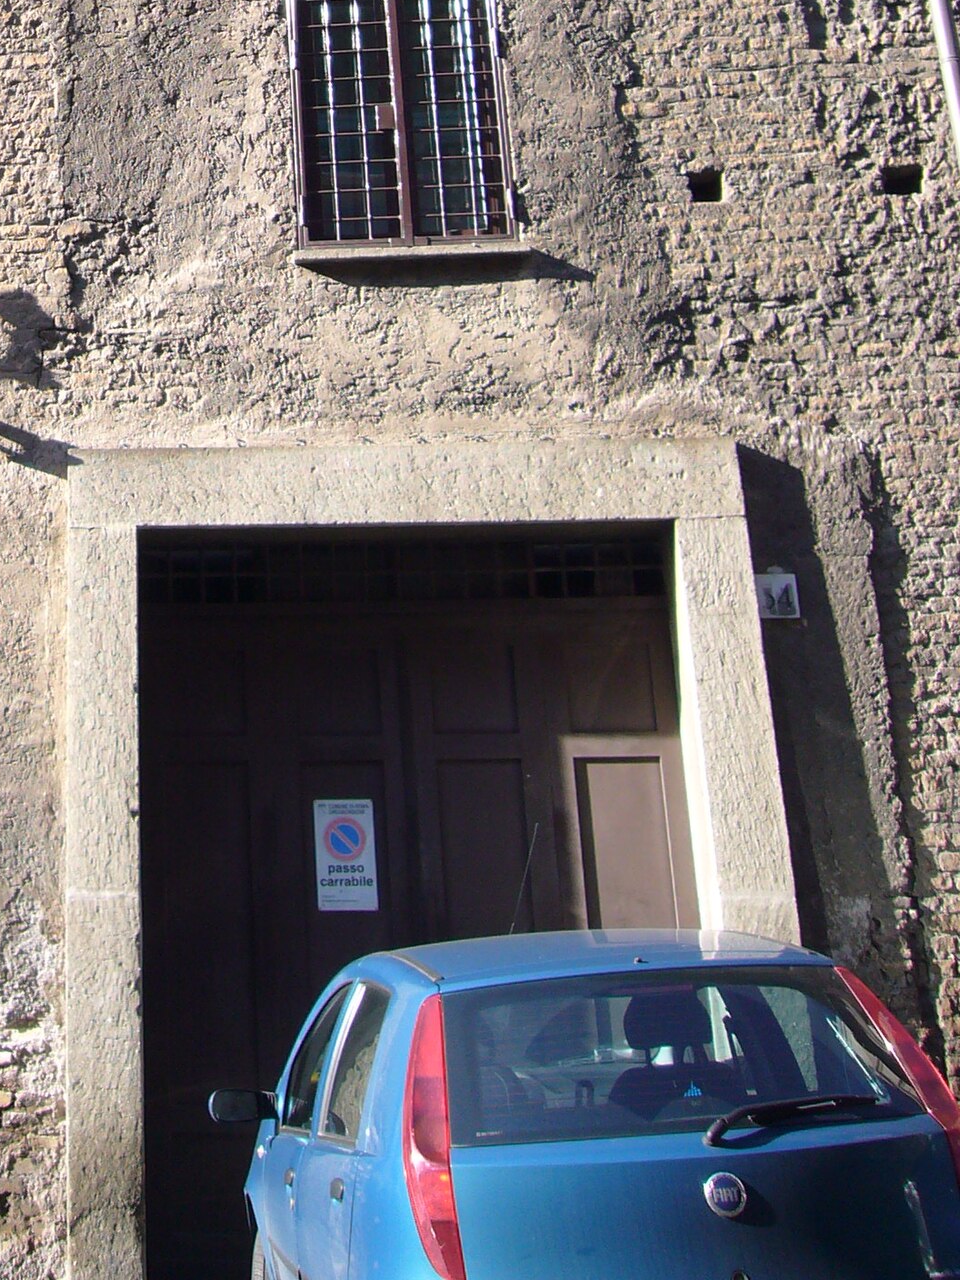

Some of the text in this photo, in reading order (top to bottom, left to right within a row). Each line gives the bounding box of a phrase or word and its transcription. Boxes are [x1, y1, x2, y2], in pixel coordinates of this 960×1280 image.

[327, 864, 365, 876] passo
[320, 876, 374, 887] carrabile
[712, 1187, 739, 1203] FIAT
